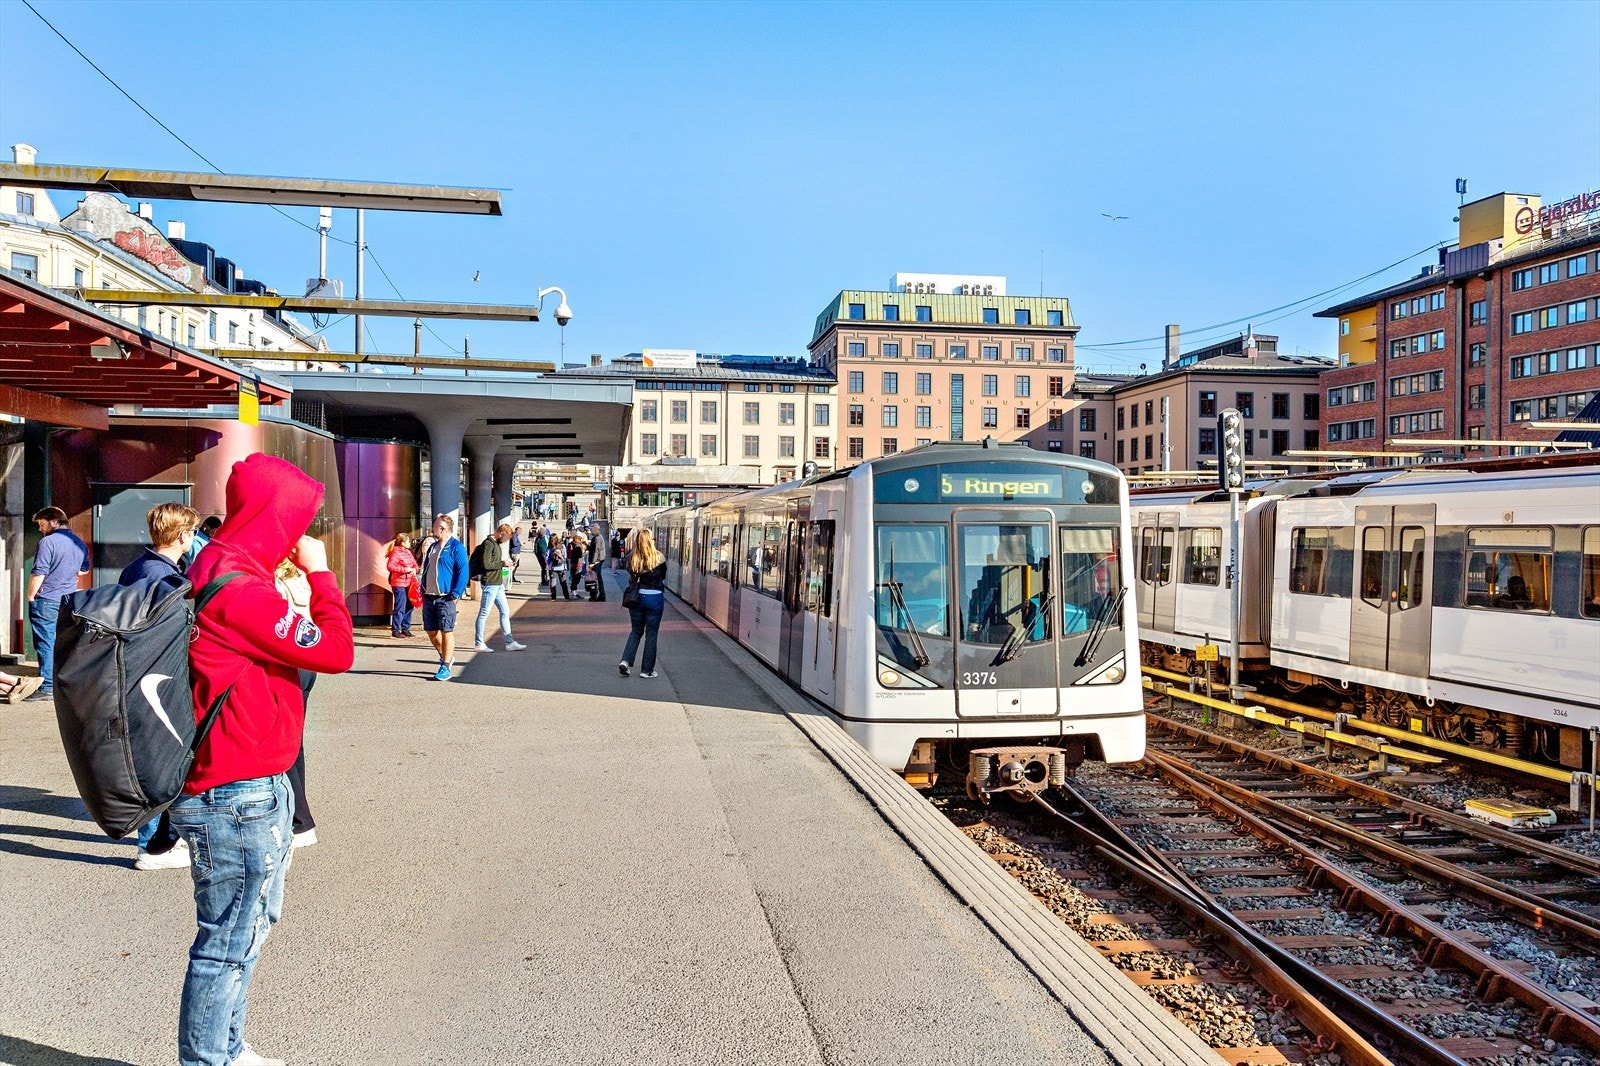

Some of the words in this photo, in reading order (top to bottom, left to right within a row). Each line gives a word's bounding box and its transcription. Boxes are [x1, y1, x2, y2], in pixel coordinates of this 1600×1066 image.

[942, 474, 953, 494] 5
[965, 478, 1049, 495] Ringen
[963, 671, 997, 685] 3376
